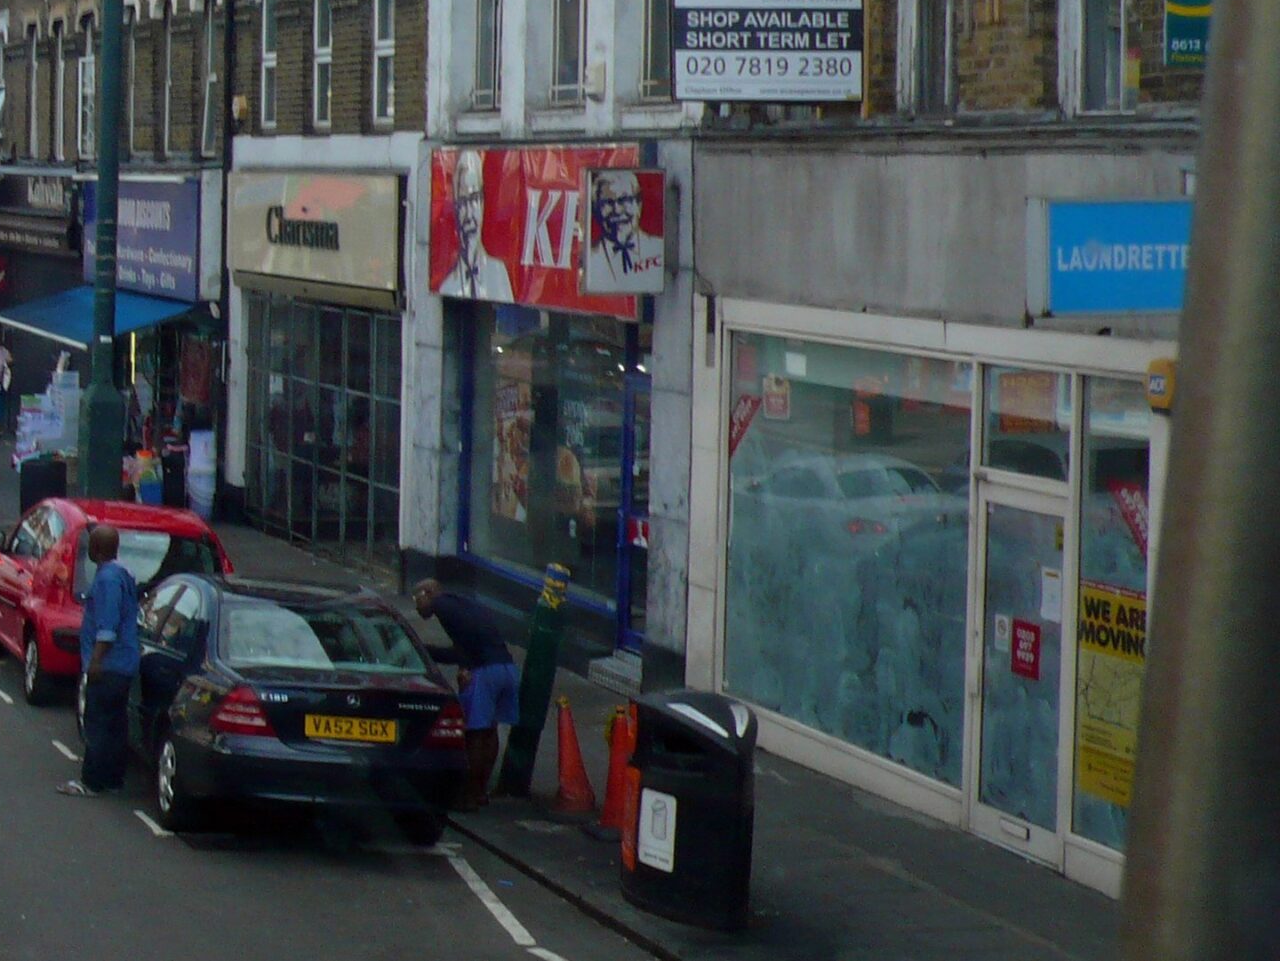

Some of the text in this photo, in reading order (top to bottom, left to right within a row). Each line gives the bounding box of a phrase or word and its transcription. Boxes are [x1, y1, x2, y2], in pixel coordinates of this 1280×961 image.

[687, 11, 849, 28] SHOP AVAILABLE
[686, 31, 851, 49] SHORT TERM LET
[686, 56, 852, 77] 020 7819 2380
[520, 189, 582, 270] KF
[633, 256, 662, 274] KFC
[1057, 243, 1190, 271] LAUNDRETTE
[1083, 596, 1111, 623] WE
[312, 716, 390, 738] VA52 SGX
